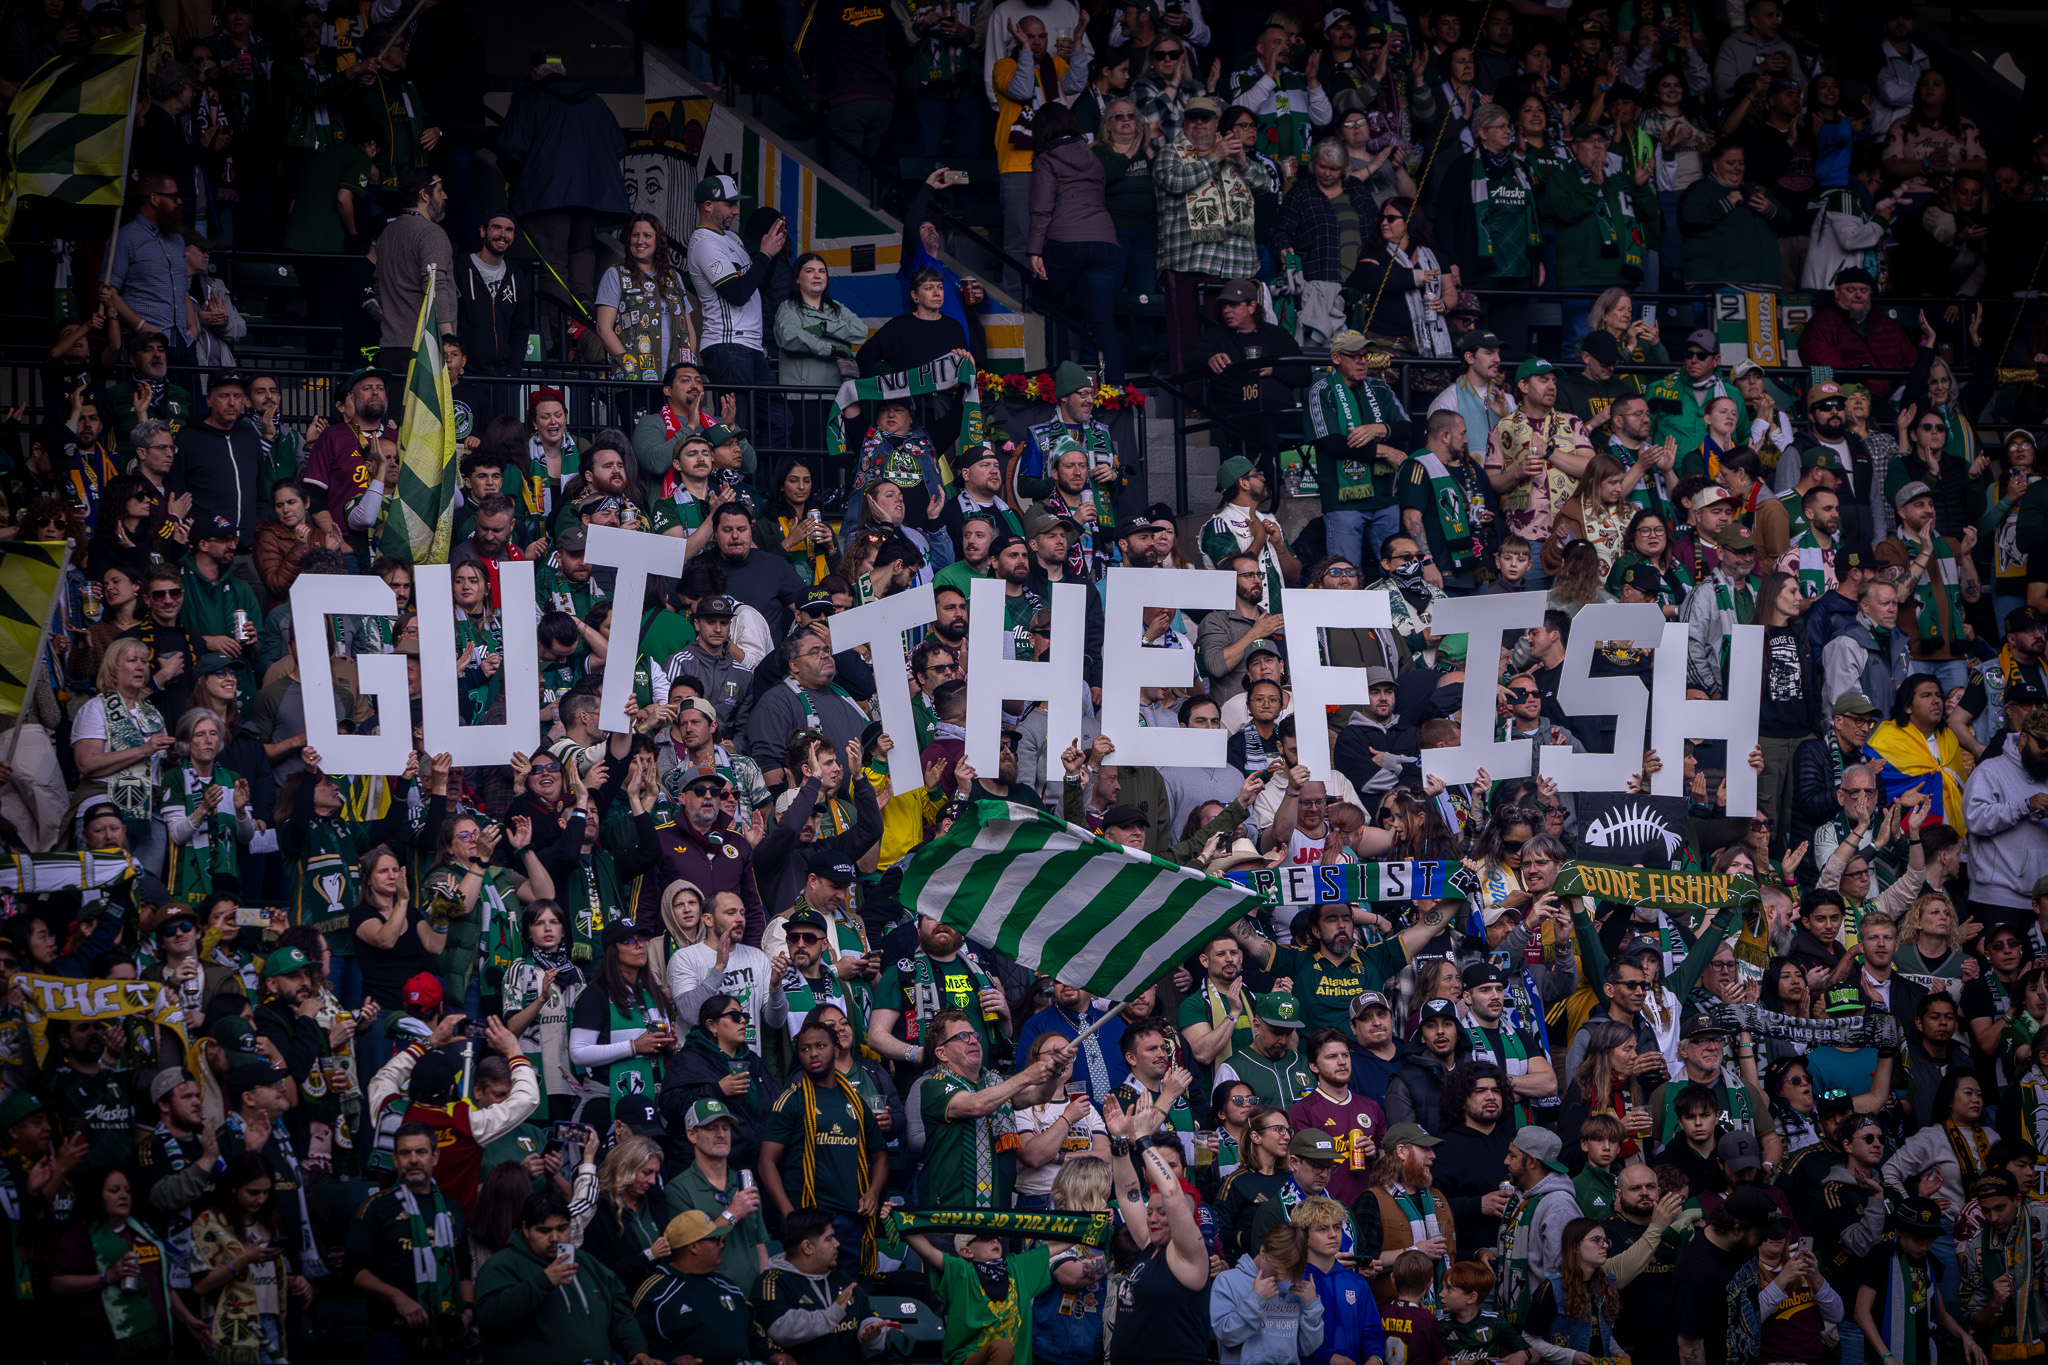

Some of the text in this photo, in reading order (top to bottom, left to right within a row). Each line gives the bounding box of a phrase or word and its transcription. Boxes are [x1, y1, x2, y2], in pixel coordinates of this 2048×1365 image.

[842, 5, 885, 23] Timbers
[929, 70, 943, 80] 107
[1914, 137, 1955, 149] Alaska
[1490, 185, 1526, 199] Alaska
[1494, 198, 1526, 206] AIRLINES
[1720, 294, 1740, 323] NO
[1752, 292, 1776, 363] Somos
[876, 354, 964, 393] NO PITY
[1242, 383, 1259, 401] 106
[1655, 386, 1679, 400] PTFC
[1334, 383, 1353, 420] CHICAGO
[838, 444, 847, 453] 10
[807, 590, 830, 601] Oregon
[289, 524, 1764, 818] GUT THE FISH
[1254, 862, 1440, 905] RESIST
[1576, 864, 1737, 904] GONE FISHIN'
[1319, 975, 1360, 987] Alaska
[1906, 974, 1953, 987] TIMBS
[32, 978, 121, 1018] THE
[1315, 985, 1363, 997] Airlines
[1756, 1008, 1865, 1030] PORTLAND
[1779, 1025, 1842, 1040] TIMBERS
[85, 1103, 130, 1121] Alaska
[644, 1106, 655, 1121] P
[815, 1131, 858, 1146] illamoo
[1737, 1140, 1749, 1155] P
[930, 1211, 1078, 1234] I'M FULL OF STARS
[1774, 1291, 1815, 1312] imber
[1276, 1320, 1296, 1330] NORT
[1381, 1317, 1413, 1334] MORA
[1450, 1347, 1489, 1362] Alaska
